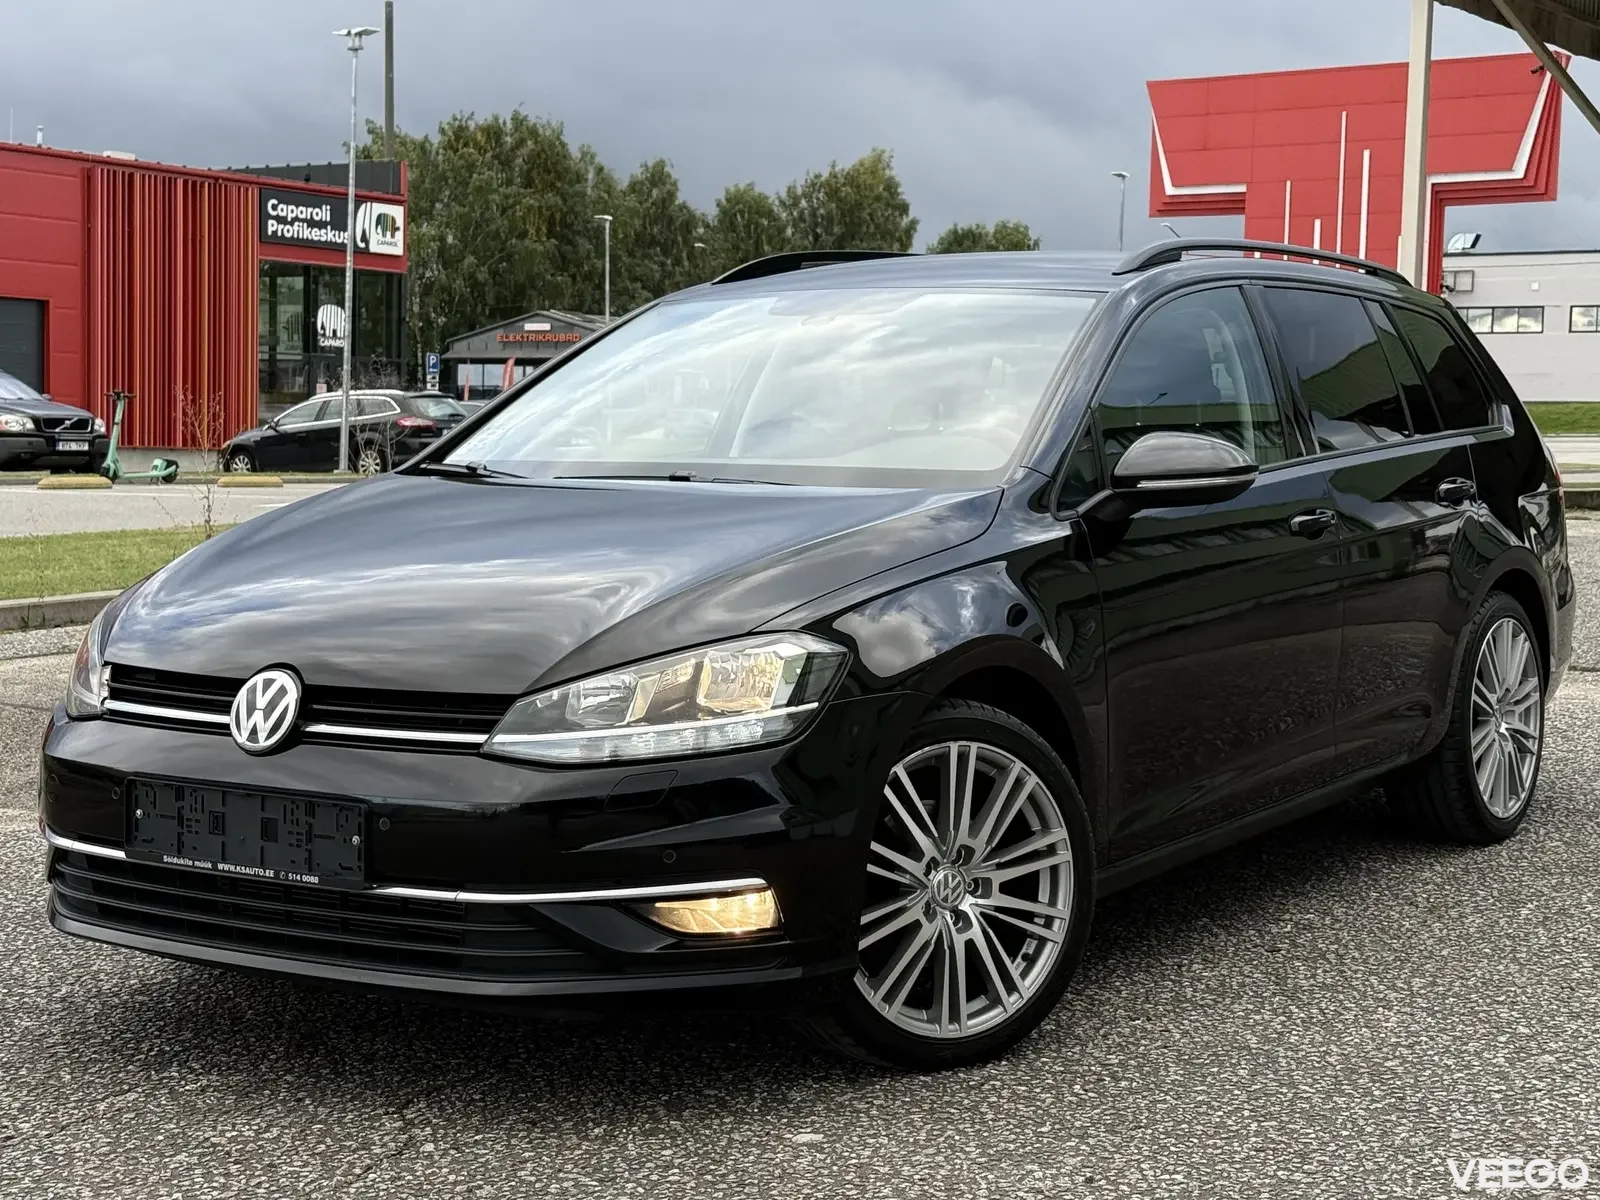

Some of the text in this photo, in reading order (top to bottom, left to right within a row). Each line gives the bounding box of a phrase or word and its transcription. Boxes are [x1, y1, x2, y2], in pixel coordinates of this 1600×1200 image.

[267, 199, 331, 222] Caparoli
[319, 338, 345, 348] CAPARO
[496, 332, 581, 343] ELEKTRIKAUBAD
[430, 355, 437, 367] P
[217, 862, 275, 878] WWW.KSAUTO.EE
[288, 872, 301, 882] 514
